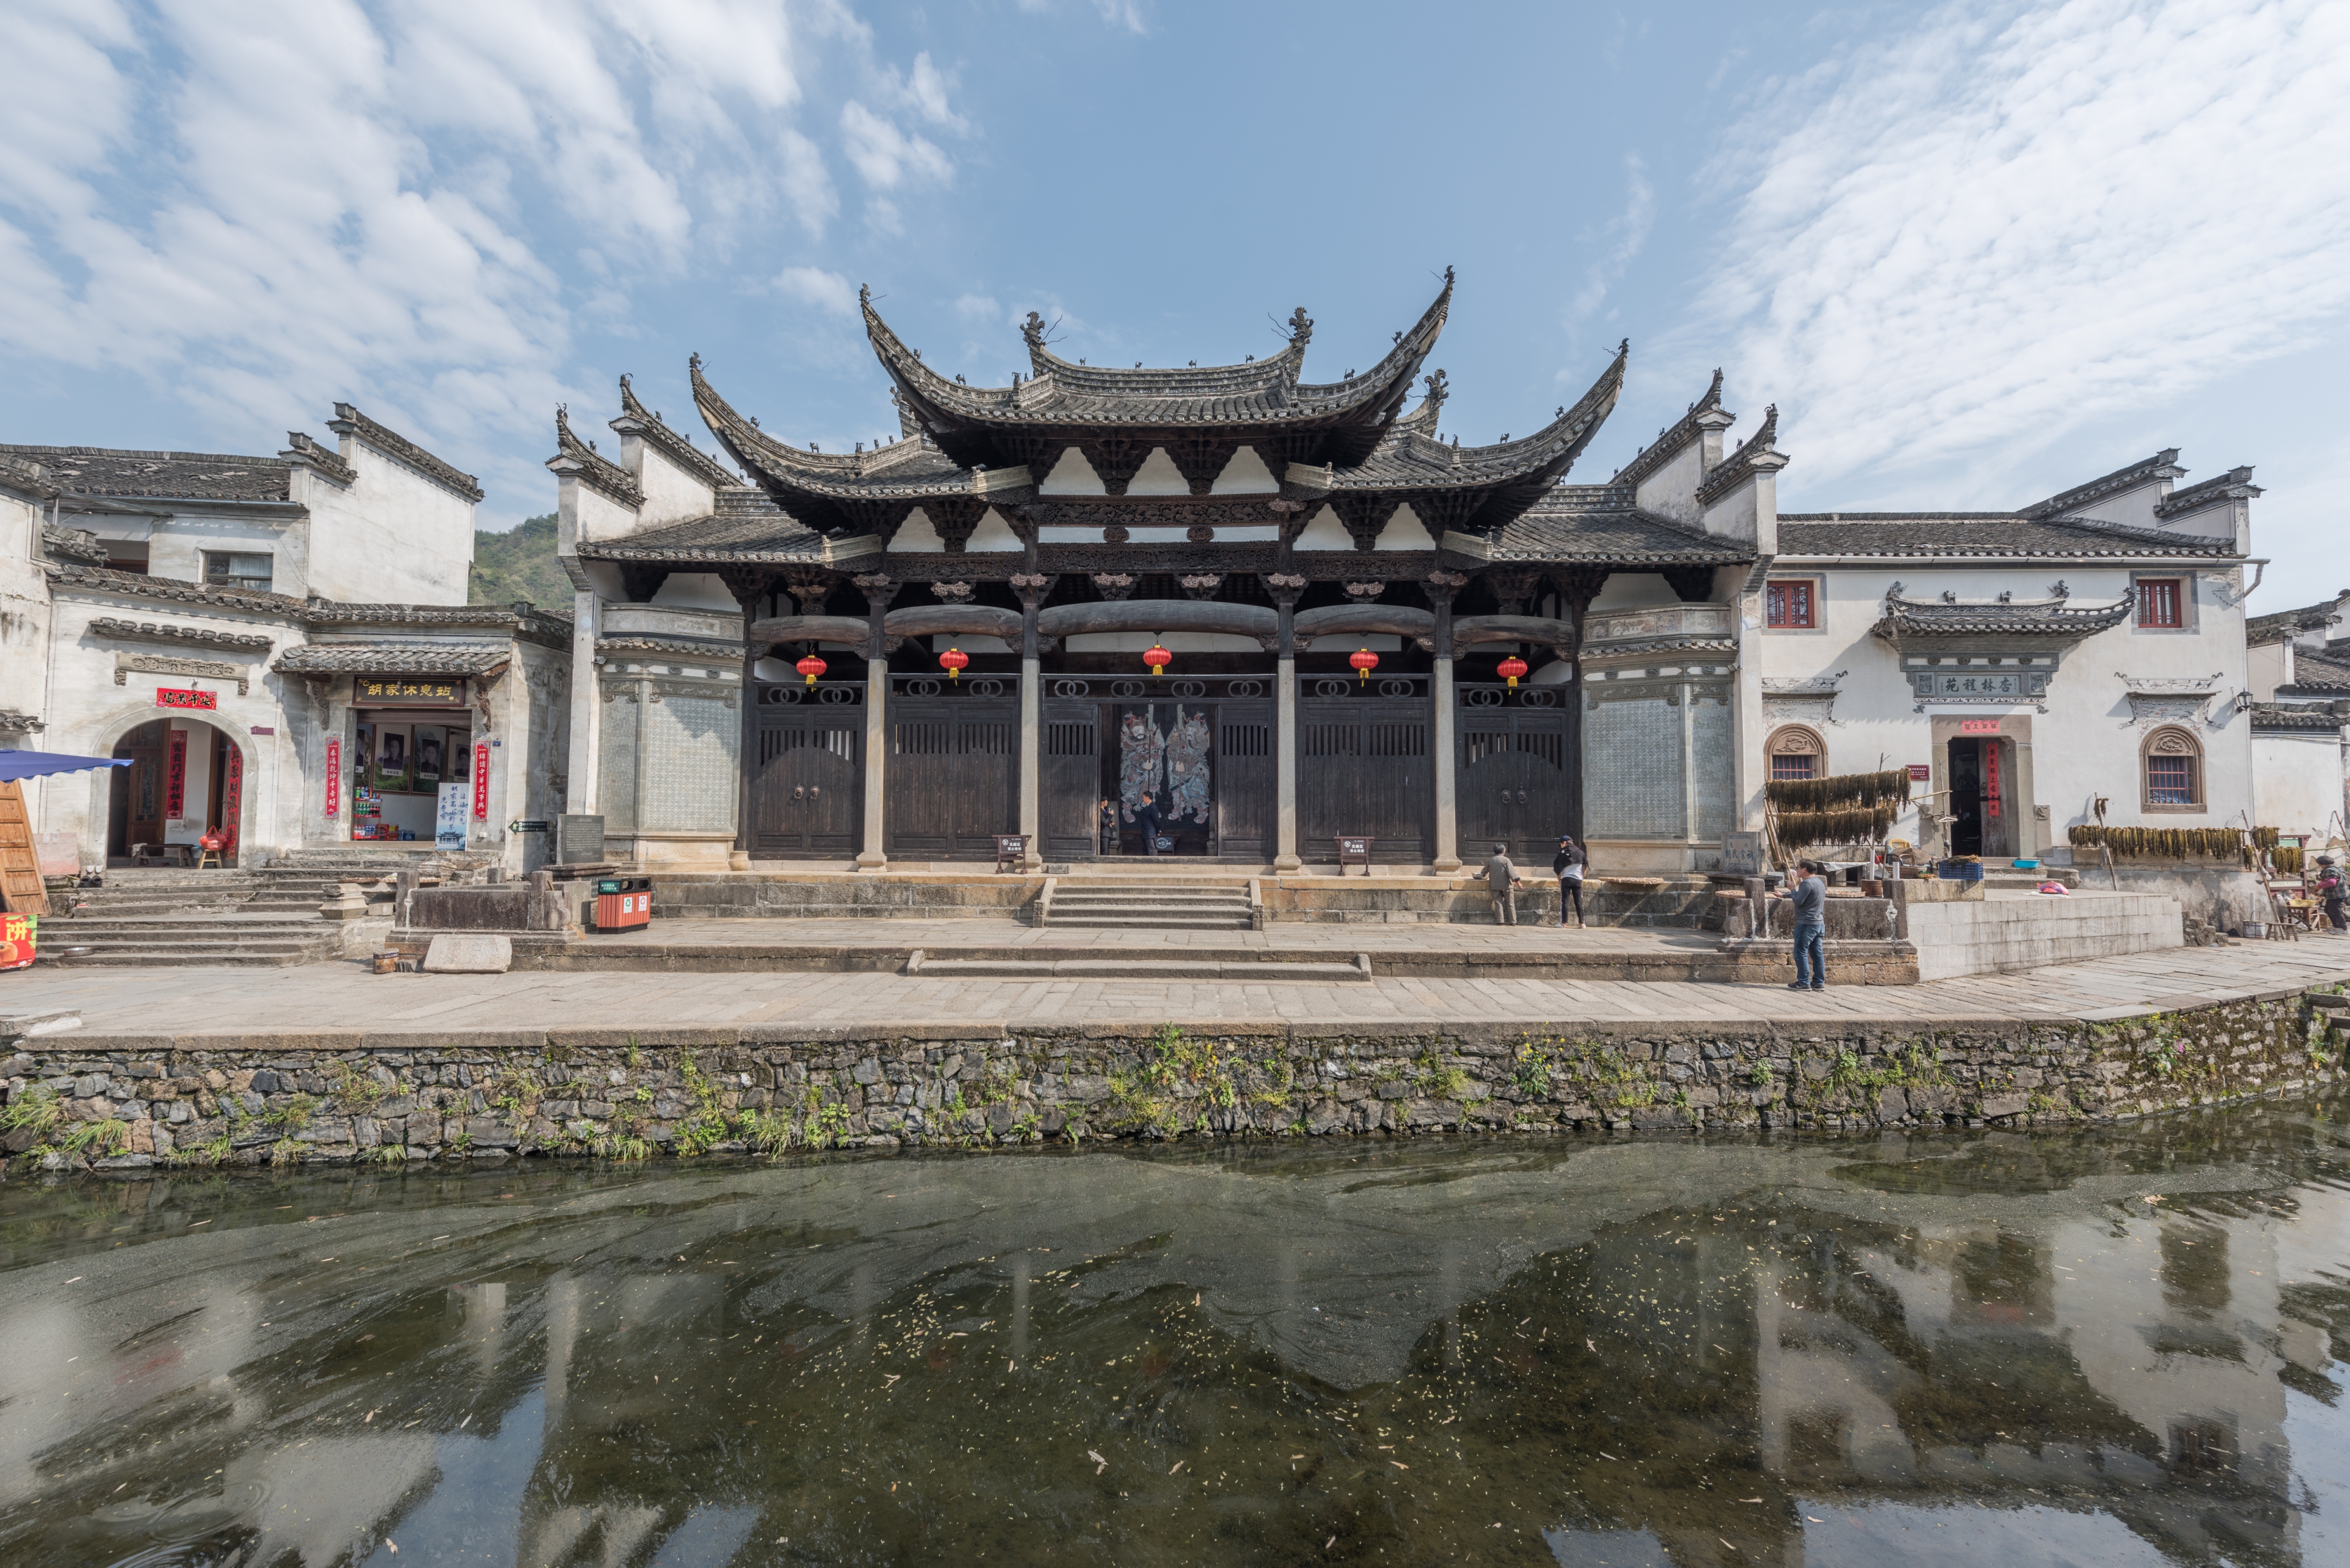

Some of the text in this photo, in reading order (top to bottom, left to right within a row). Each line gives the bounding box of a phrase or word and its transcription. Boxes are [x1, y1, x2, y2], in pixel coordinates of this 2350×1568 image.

[368, 684, 452, 697] 胡家休息站
[448, 786, 458, 831] 胡家高山野茶
[1725, 849, 1754, 861] 胡氏宗祠
[6, 921, 28, 942] 饼
